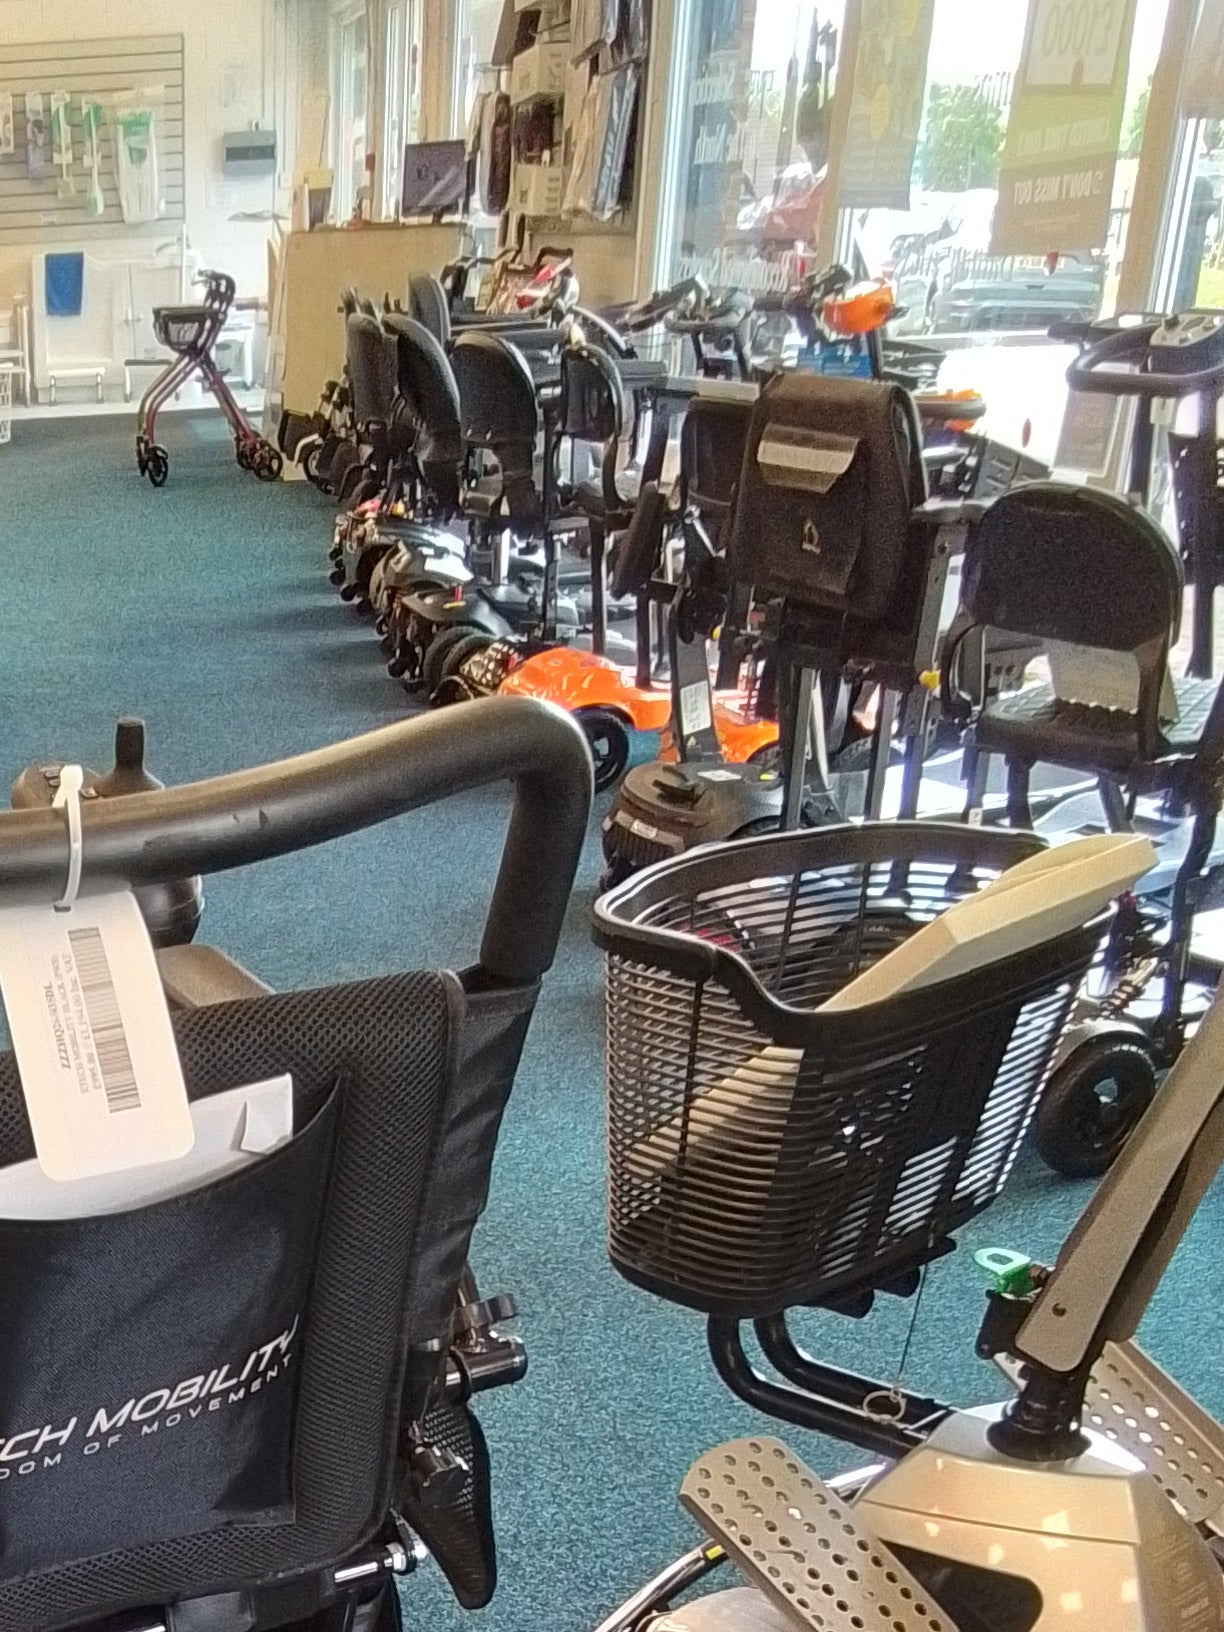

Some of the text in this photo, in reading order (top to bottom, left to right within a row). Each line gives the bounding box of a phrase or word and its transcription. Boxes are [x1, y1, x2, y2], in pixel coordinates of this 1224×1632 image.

[83, 1434, 122, 1456] OF
[140, 1354, 293, 1439] MOVEMENT
[89, 1313, 301, 1435] MOBILITY
